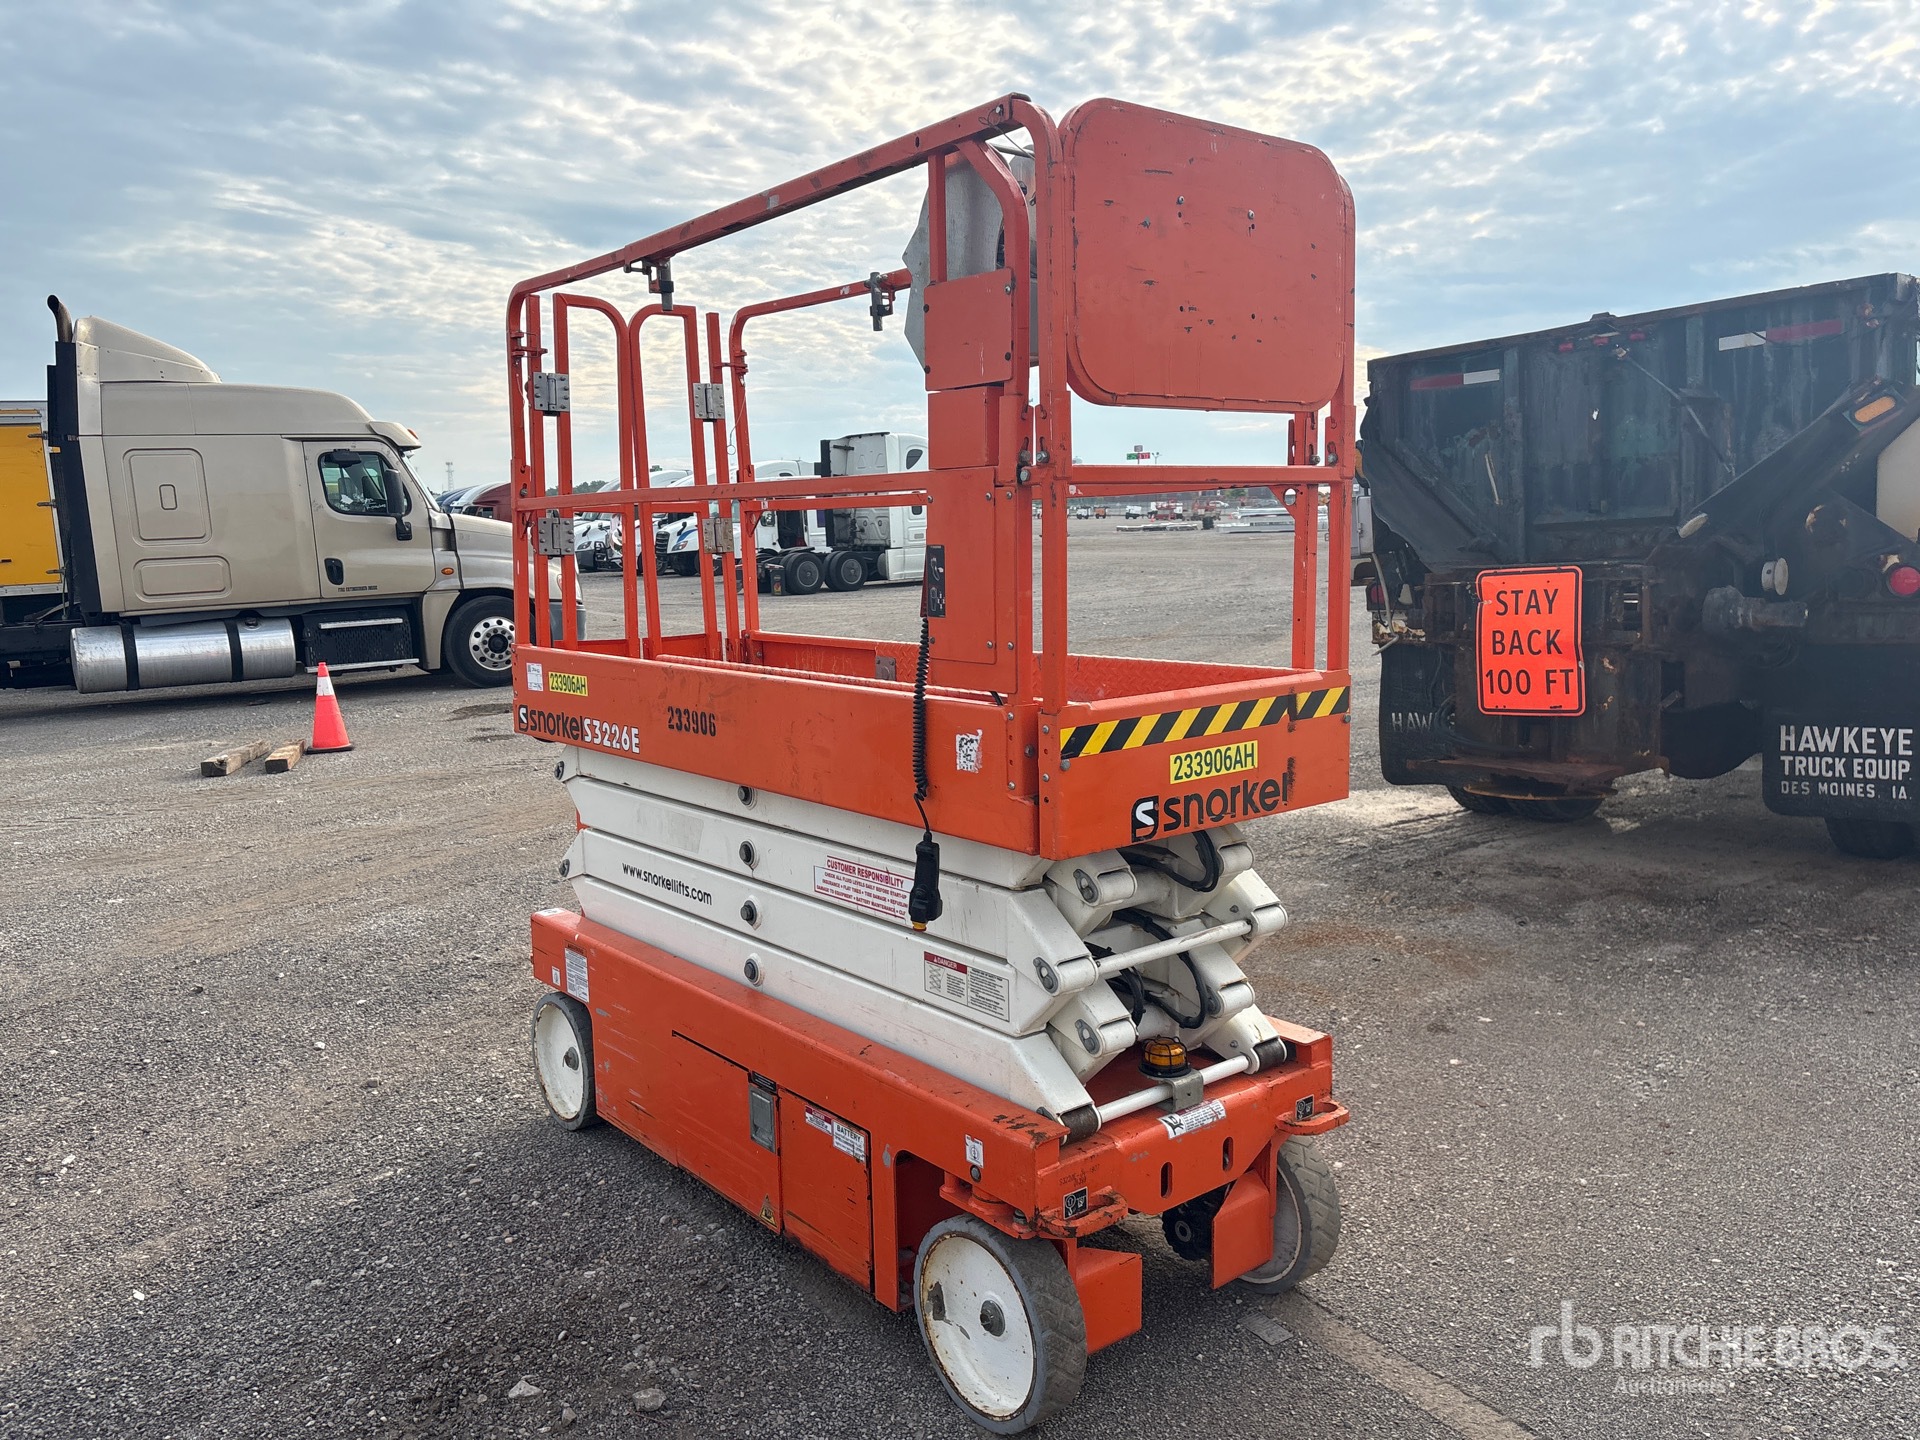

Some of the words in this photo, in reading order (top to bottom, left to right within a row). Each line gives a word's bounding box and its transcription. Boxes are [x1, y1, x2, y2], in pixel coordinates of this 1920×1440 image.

[1495, 588, 1559, 616] STAY
[1492, 629, 1563, 656] BACK
[550, 673, 586, 694] 233906AH
[1485, 669, 1531, 695] 100
[1545, 669, 1574, 695] FT
[529, 709, 585, 741] snorkel
[583, 717, 640, 754] S3226E
[667, 706, 717, 737] 233906
[1780, 725, 1914, 756] HAWKEYE
[1174, 743, 1256, 780] 233906AH
[1780, 755, 1847, 778] TRUCK
[1853, 758, 1912, 781] EQUIP.
[1781, 780, 1811, 795] DES
[1163, 772, 1288, 832] snorkel
[622, 862, 712, 906] www.snorkellifts.com
[826, 860, 857, 875] CUSTOMER
[857, 868, 904, 888] RESPONSIBILITY
[938, 957, 957, 969] DANGER
